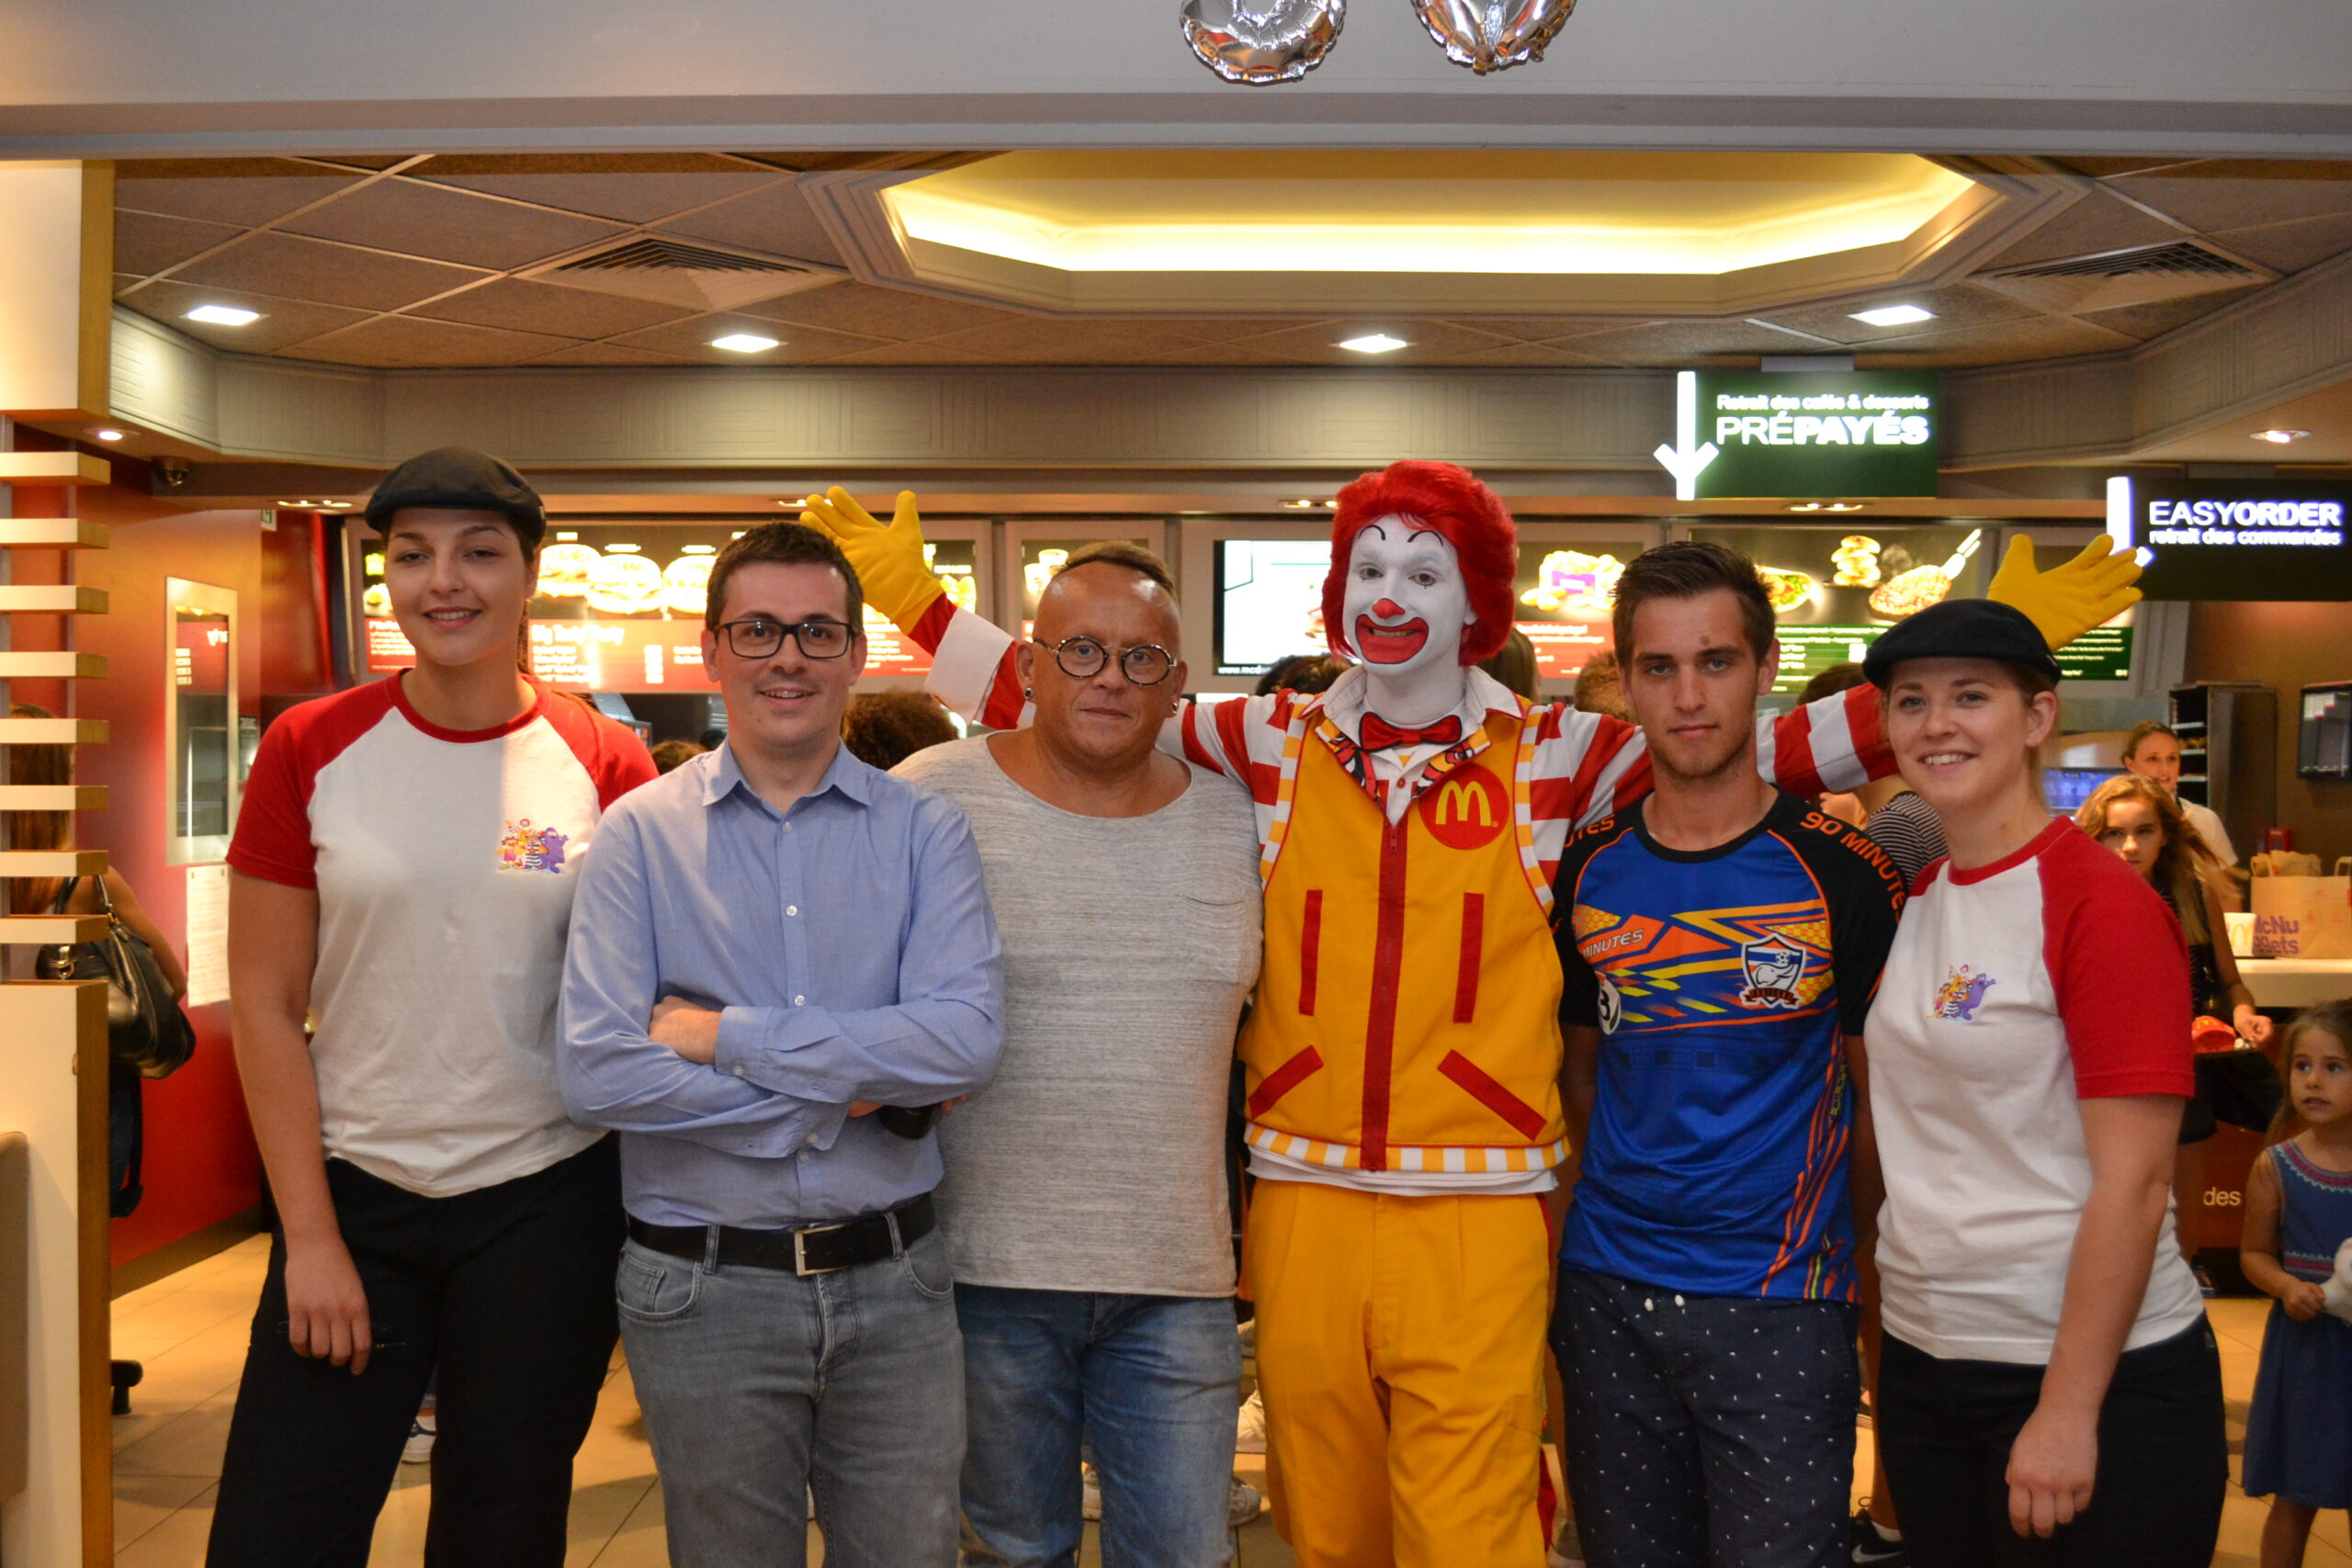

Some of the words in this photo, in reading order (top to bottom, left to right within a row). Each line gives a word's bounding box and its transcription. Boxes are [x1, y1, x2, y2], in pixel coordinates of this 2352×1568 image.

[1716, 394, 1770, 410] Retrait
[1770, 394, 1801, 410] des
[1847, 394, 1861, 410] &
[1862, 394, 1929, 410] desserts
[1716, 411, 1929, 445] PRÉPAYÉS
[2149, 502, 2341, 525] EASYORDER
[2149, 527, 2200, 544] retrait
[2201, 527, 2235, 545] des
[2236, 528, 2341, 545] commandes
[1800, 811, 1843, 835] 90
[2202, 1186, 2242, 1207] des
